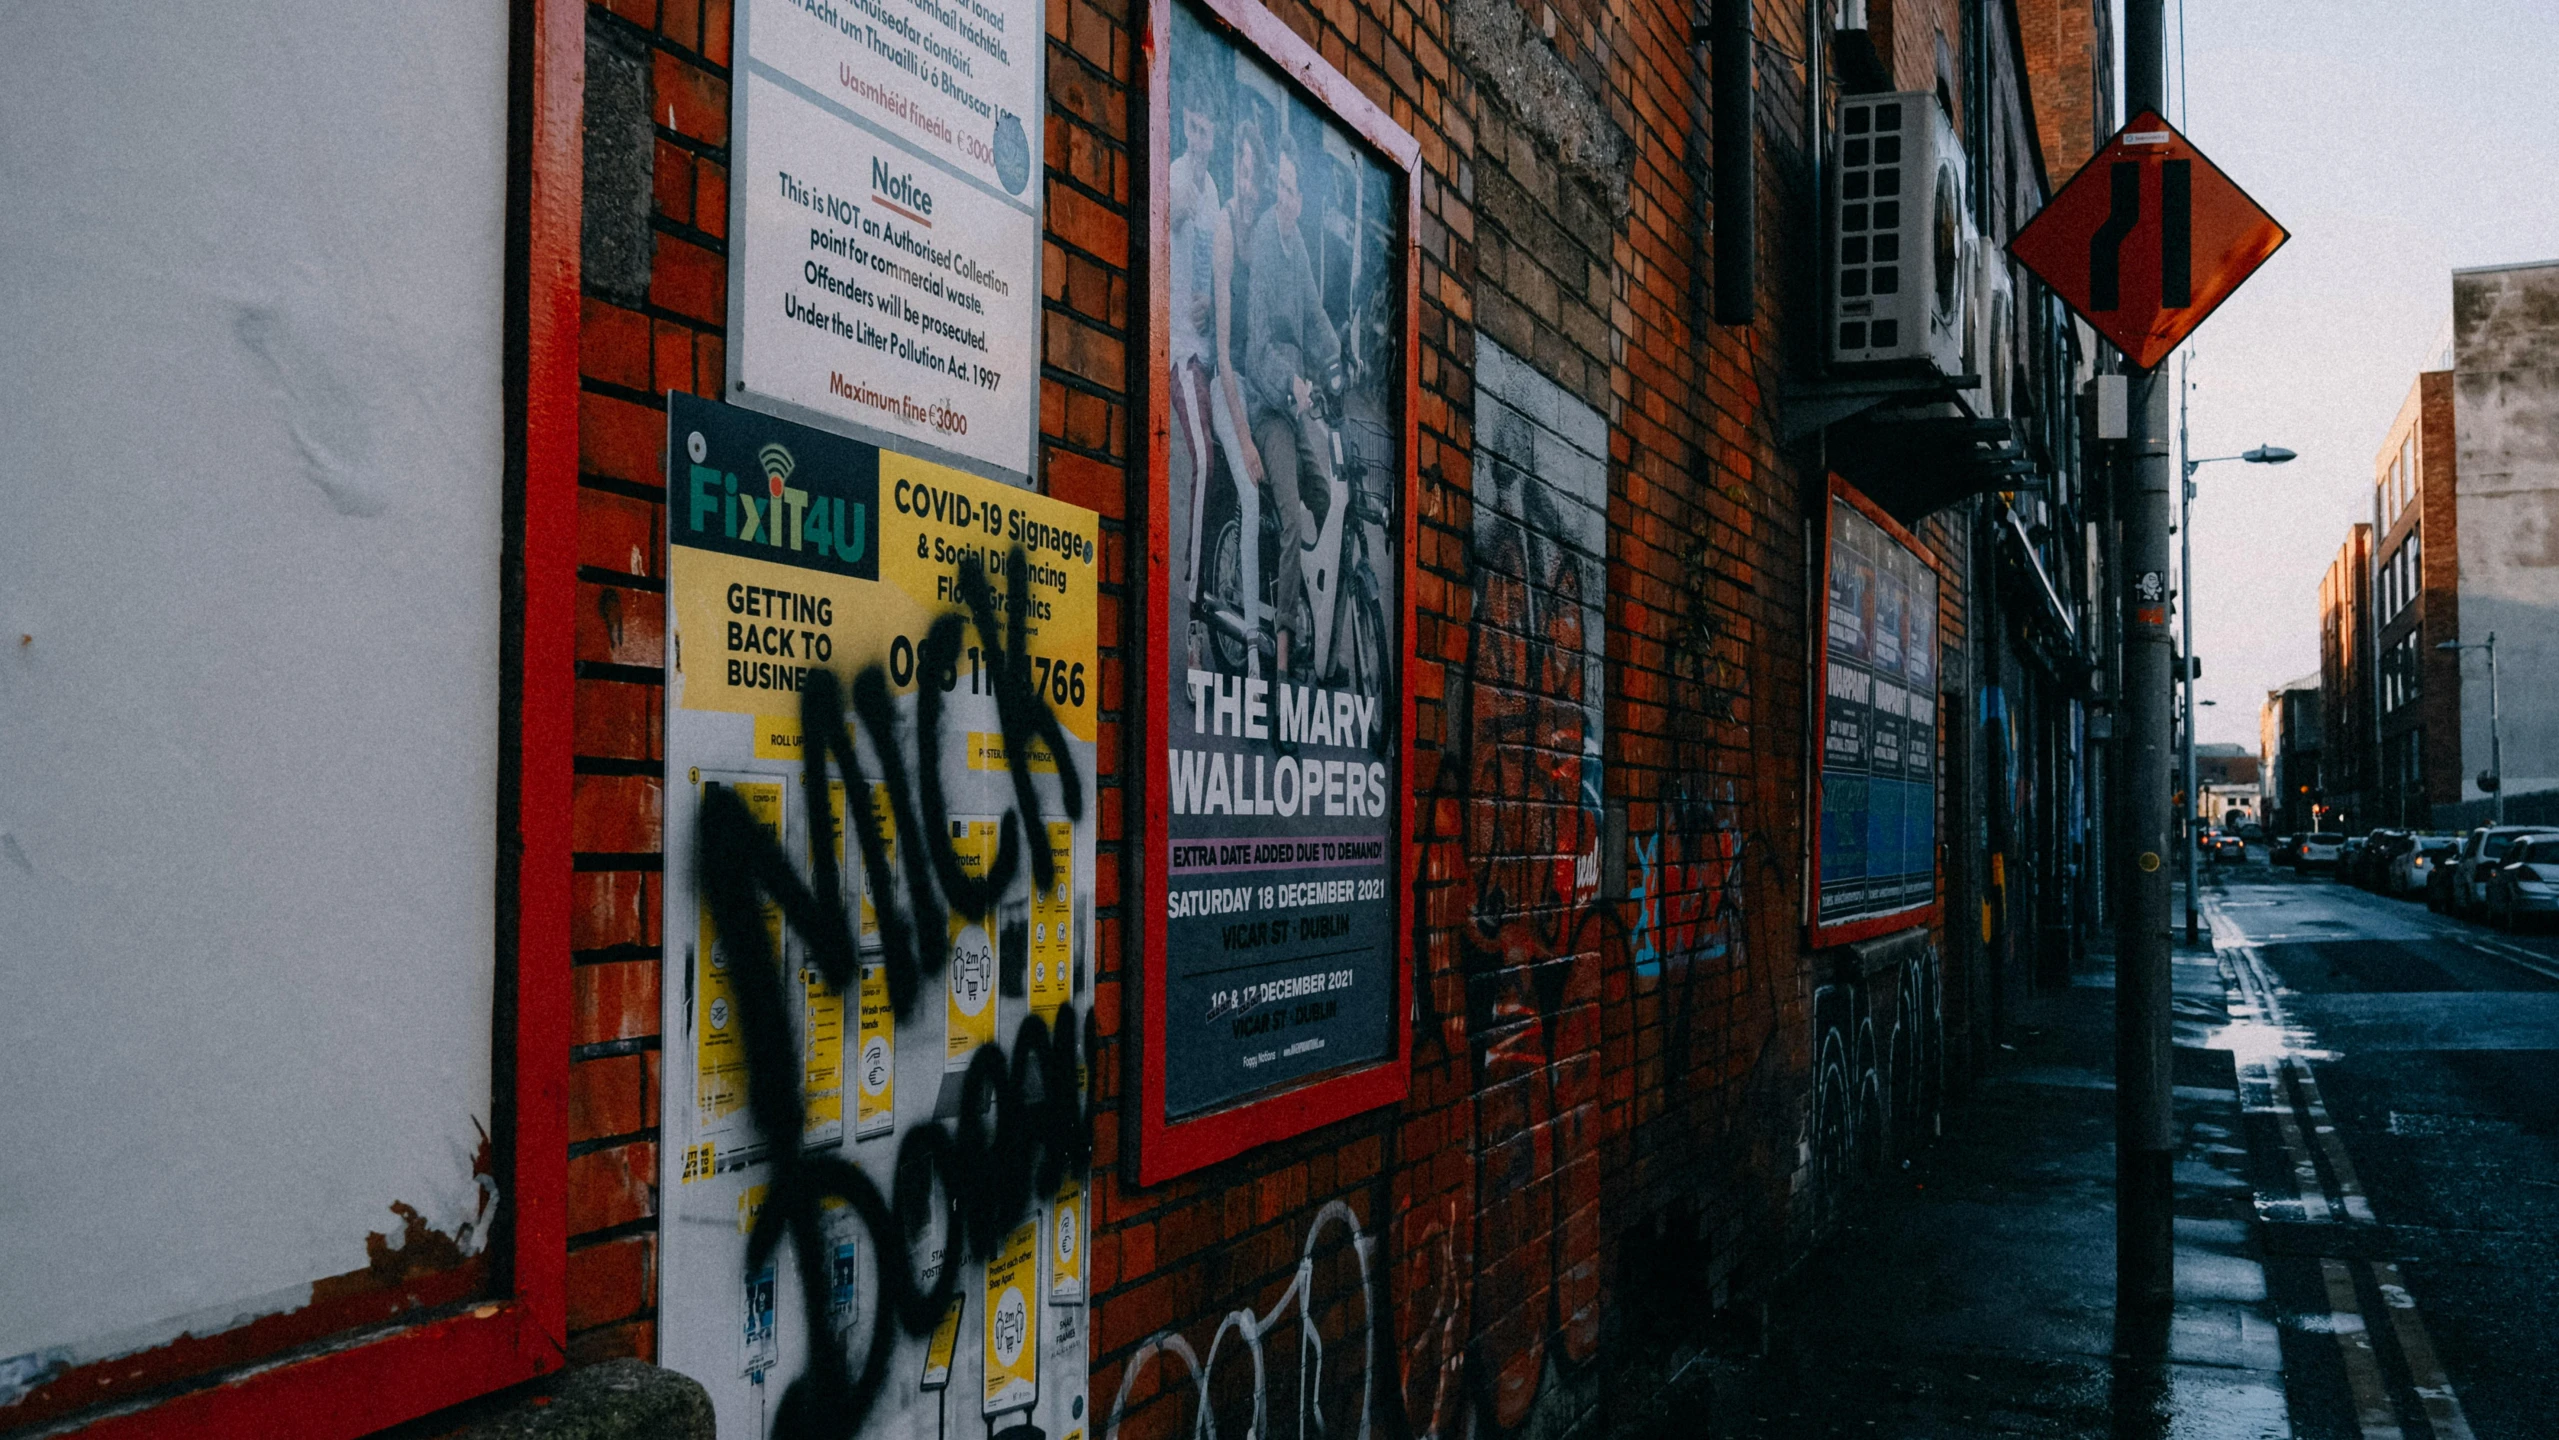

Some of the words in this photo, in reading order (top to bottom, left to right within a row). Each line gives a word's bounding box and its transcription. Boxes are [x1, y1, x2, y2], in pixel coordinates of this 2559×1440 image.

[805, 0, 837, 28] Acht
[840, 17, 862, 43] um
[932, 66, 939, 87] ó
[942, 71, 992, 118] Bhruscar
[924, 32, 973, 78] ciontóirí.
[959, 17, 1010, 66] tráchtála.
[840, 61, 907, 119] Uasmhéid
[910, 104, 952, 144] fíneála
[872, 155, 932, 215] Notice
[779, 171, 809, 207] This
[813, 188, 824, 213] is
[827, 194, 861, 229] NOT
[863, 218, 880, 239] an
[884, 222, 951, 271] Authorised
[954, 253, 1009, 297] Collection
[811, 228, 846, 257] point
[850, 238, 869, 266] for
[871, 254, 943, 298] commercial
[946, 285, 985, 316] waste.
[805, 260, 874, 308] Offenders
[877, 291, 901, 319] will
[904, 299, 919, 326] be
[922, 315, 988, 353] prosecuted.
[785, 292, 829, 330] Under
[832, 312, 853, 339] the
[856, 319, 888, 352] Litter
[890, 332, 945, 373] Pollution
[947, 355, 970, 382] Act.
[973, 364, 1001, 392] 1997
[830, 371, 900, 414] Maximum
[903, 395, 927, 423] fine
[929, 403, 968, 436] €3000
[894, 479, 1002, 536] COVID-19
[1008, 509, 1082, 560] Signage
[917, 533, 929, 559] &
[727, 583, 832, 627] GETTING
[728, 621, 795, 658] BACK
[801, 630, 832, 662] TO
[728, 659, 812, 692] BUSINE
[1188, 668, 1269, 740] THE
[1279, 683, 1375, 749] MARY
[771, 734, 791, 746] ROLL
[1169, 748, 1386, 818] WALLOPERS
[1173, 846, 1217, 868] EXTRA
[1220, 845, 1251, 867] DATE
[1254, 844, 1294, 865] ADDED
[1296, 843, 1320, 862] DUE
[1322, 842, 1336, 861] TO
[1338, 841, 1382, 860] DEMAND!
[1168, 886, 1253, 919] SATURDAY
[1257, 885, 1274, 910] 18
[1278, 879, 1355, 909] DECEMBER
[1358, 878, 1385, 901] 2021
[1222, 921, 1267, 950] VICAR
[1271, 919, 1290, 945] ST
[1300, 914, 1350, 941] DUBLIN
[966, 951, 979, 964] 2m
[861, 1005, 878, 1015] Wash
[1231, 989, 1239, 1010] &
[1260, 973, 1326, 1004] DECEMBER
[1327, 969, 1353, 990] 2021
[1232, 1013, 1269, 1040] VICAR
[1272, 1008, 1287, 1031] ST
[1295, 1000, 1337, 1025] DUBLIN
[1243, 1055, 1258, 1069] Foggy
[989, 1262, 1006, 1277] Protect
[1007, 1256, 1018, 1269] each
[1018, 1250, 1032, 1264] other
[989, 1278, 1001, 1291] Shop
[1001, 1271, 1015, 1285] Apart
[1005, 1312, 1014, 1323] 2m
